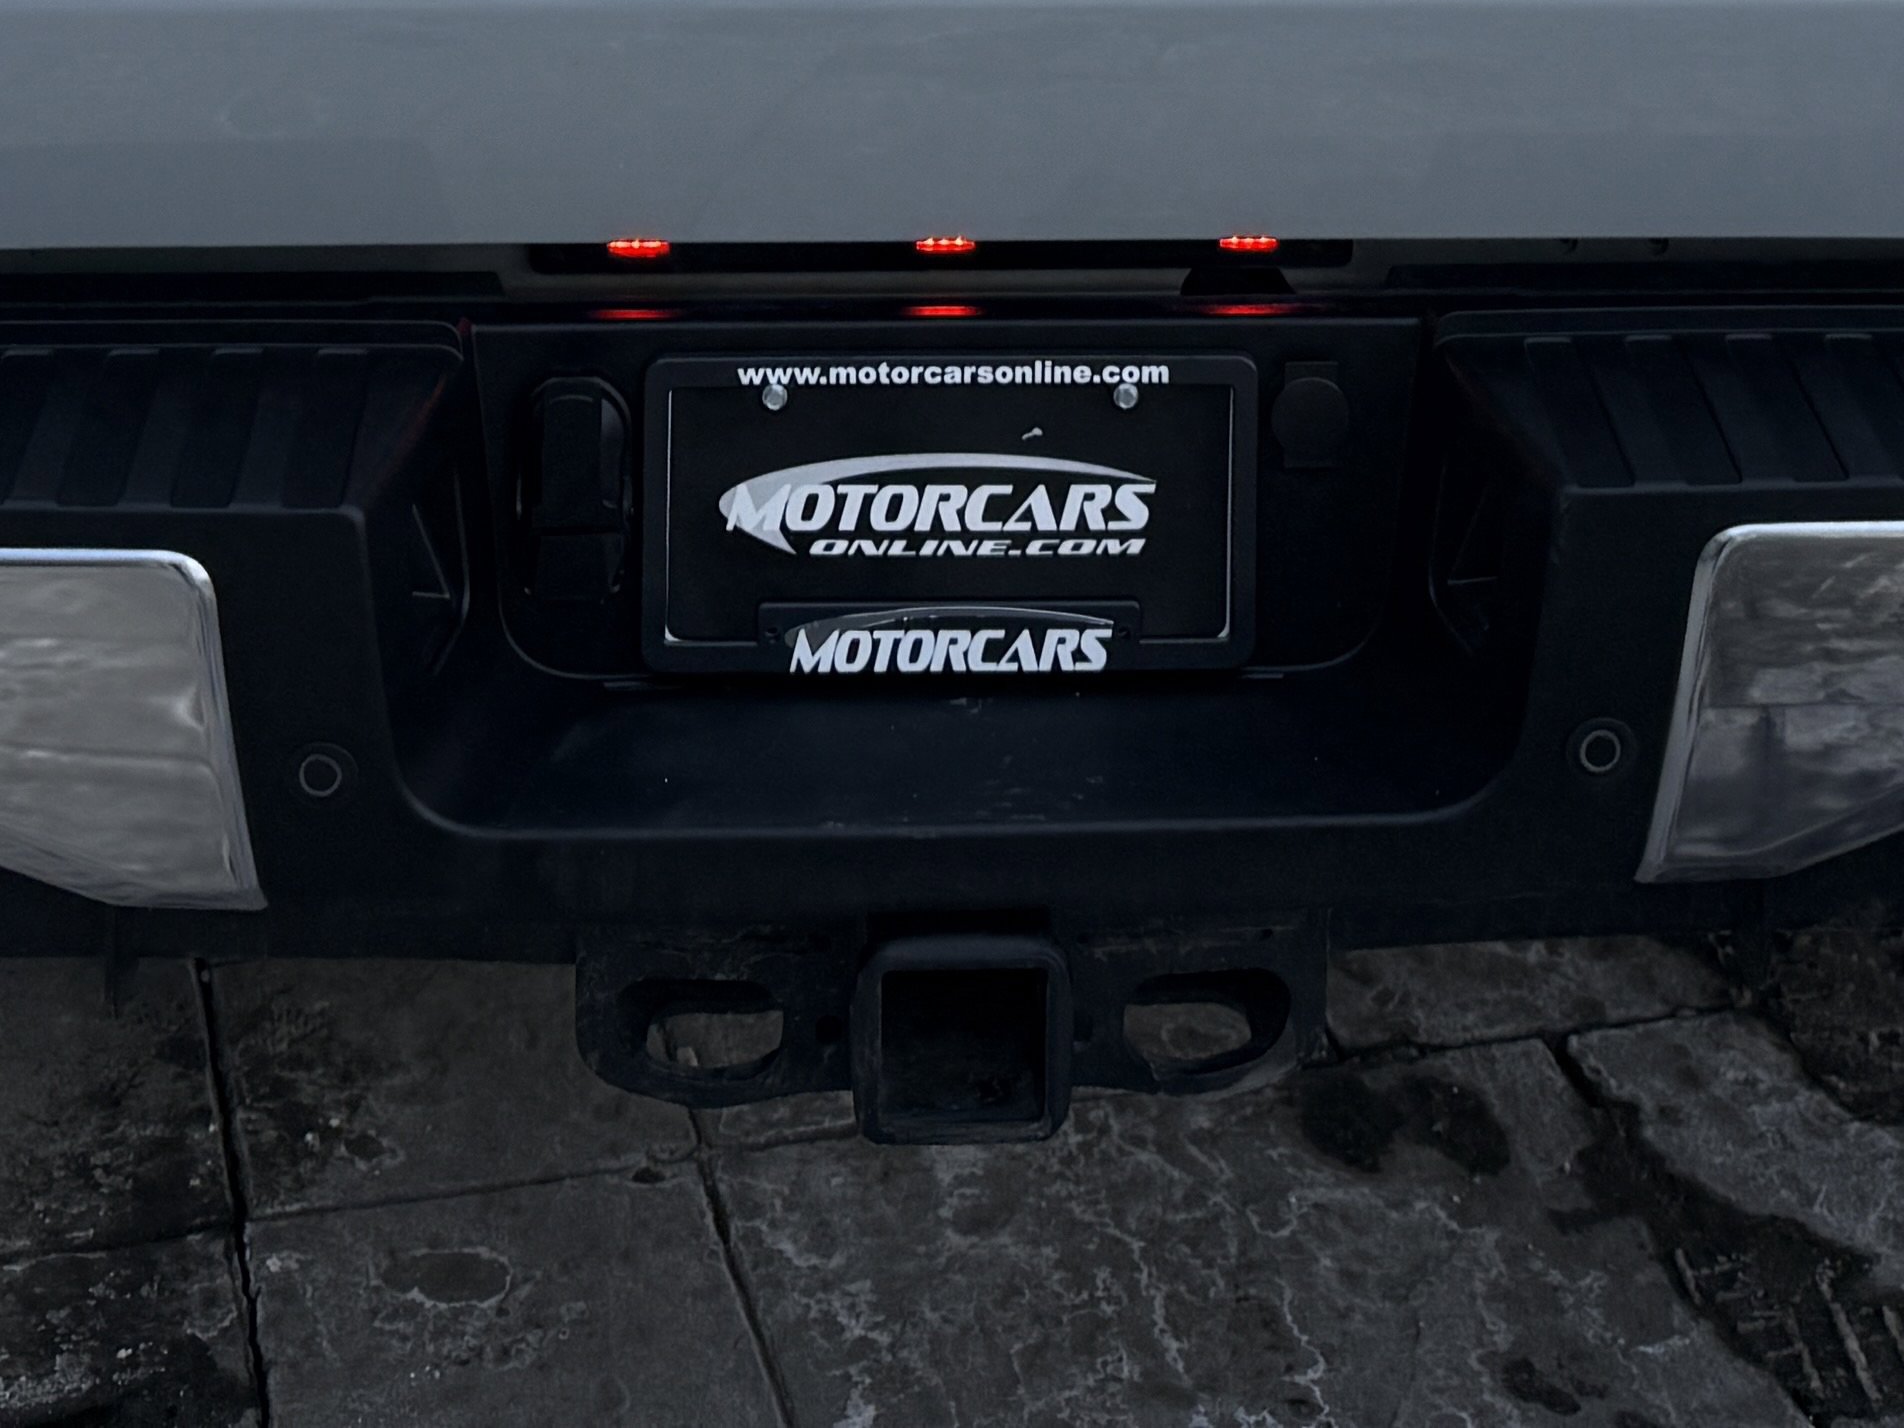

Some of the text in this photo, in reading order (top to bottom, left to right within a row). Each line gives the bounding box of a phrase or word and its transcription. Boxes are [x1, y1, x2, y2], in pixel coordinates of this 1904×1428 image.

[737, 360, 1171, 386] www.motorcarsonline.com
[725, 482, 1158, 532] MOTORCARS
[808, 538, 1147, 556] ONLINE.COM
[789, 628, 1115, 673] MOTORCARS
